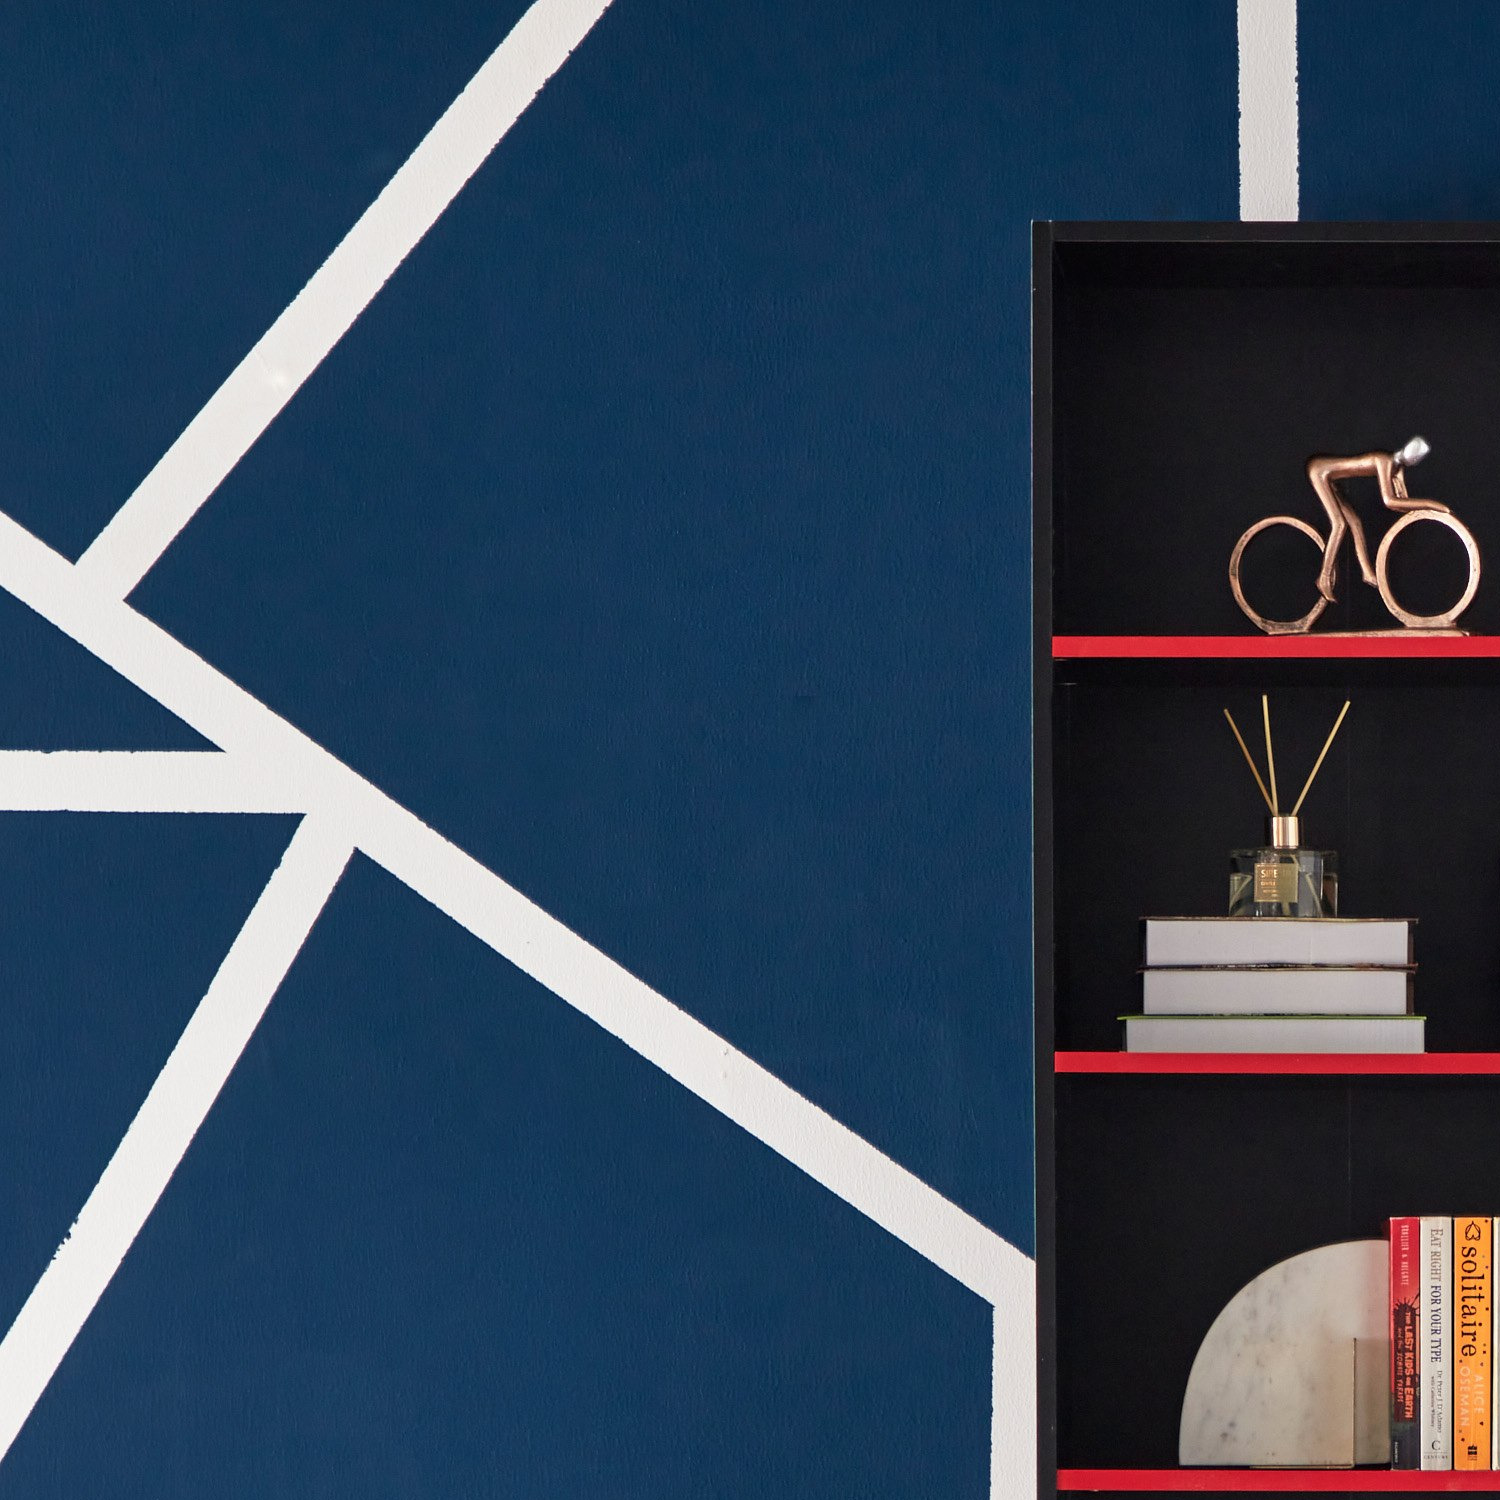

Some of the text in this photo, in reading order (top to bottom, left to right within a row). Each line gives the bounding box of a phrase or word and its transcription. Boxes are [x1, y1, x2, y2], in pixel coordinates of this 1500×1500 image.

[1430, 1250, 1442, 1282] RIGHT
[1430, 1284, 1442, 1305] FOR
[1460, 1246, 1485, 1357] solitaire
[1430, 1307, 1442, 1335] YOUR
[1404, 1326, 1414, 1351] LAST
[1430, 1338, 1442, 1363] TYPE
[1404, 1352, 1414, 1376] KIDS
[1404, 1387, 1414, 1418] EARTH
[1458, 1366, 1471, 1427] OSEMAN
[1472, 1373, 1485, 1415] ALICE
